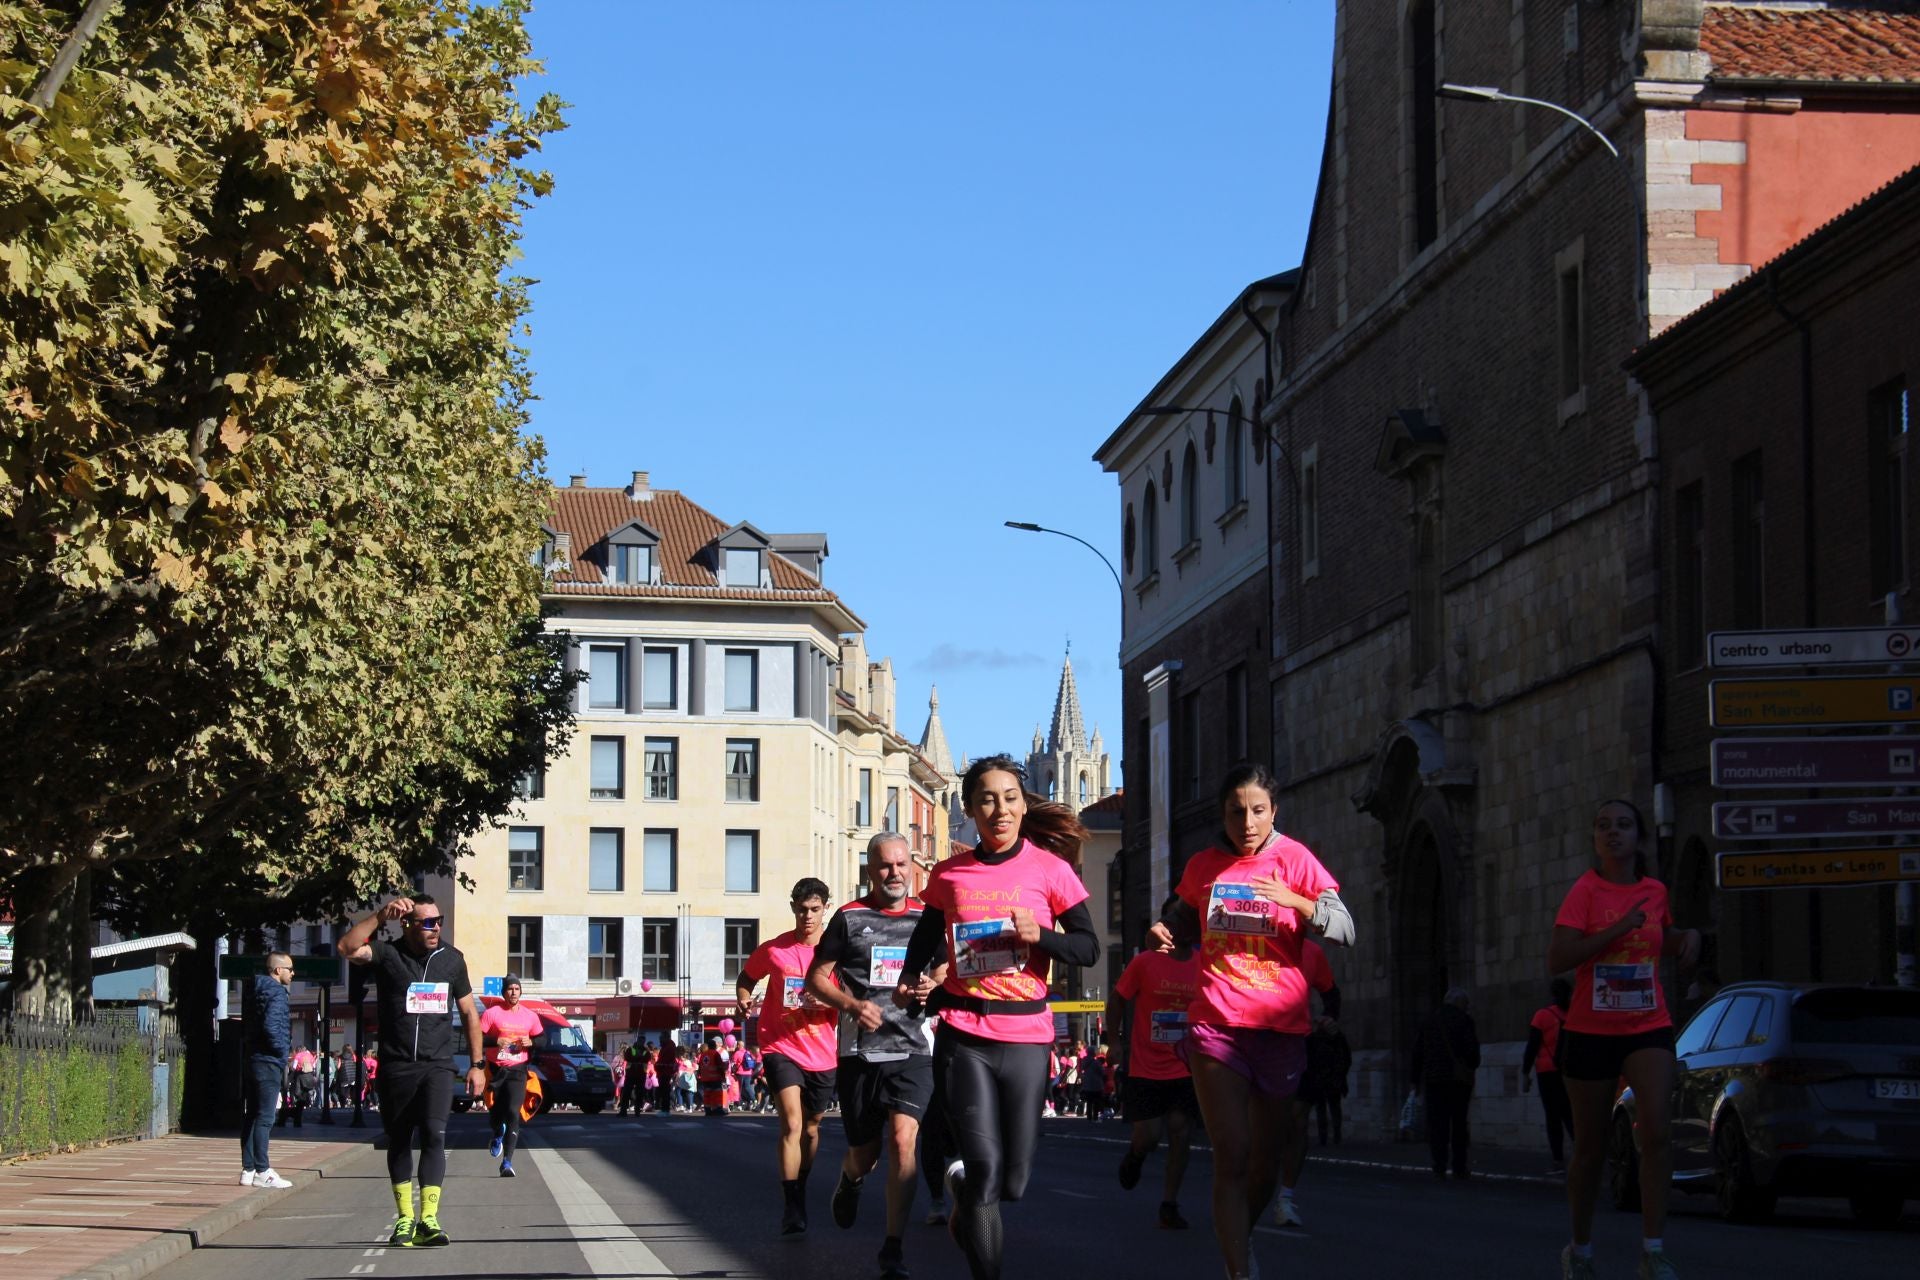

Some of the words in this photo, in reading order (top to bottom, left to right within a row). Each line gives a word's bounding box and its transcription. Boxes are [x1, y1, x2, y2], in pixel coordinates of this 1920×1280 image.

[1720, 643, 1769, 657] centro
[1780, 642, 1832, 656] urbano
[1722, 704, 1752, 718] San
[1762, 702, 1825, 717] Marcelo
[1722, 750, 1748, 760] zona
[1723, 763, 1817, 778] monumental
[1847, 810, 1878, 824] San
[1725, 864, 1745, 878] FC
[1849, 858, 1886, 872] León
[1234, 900, 1270, 914] 3068
[422, 993, 442, 1001] 4356
[1879, 1081, 1919, 1097] 5731
